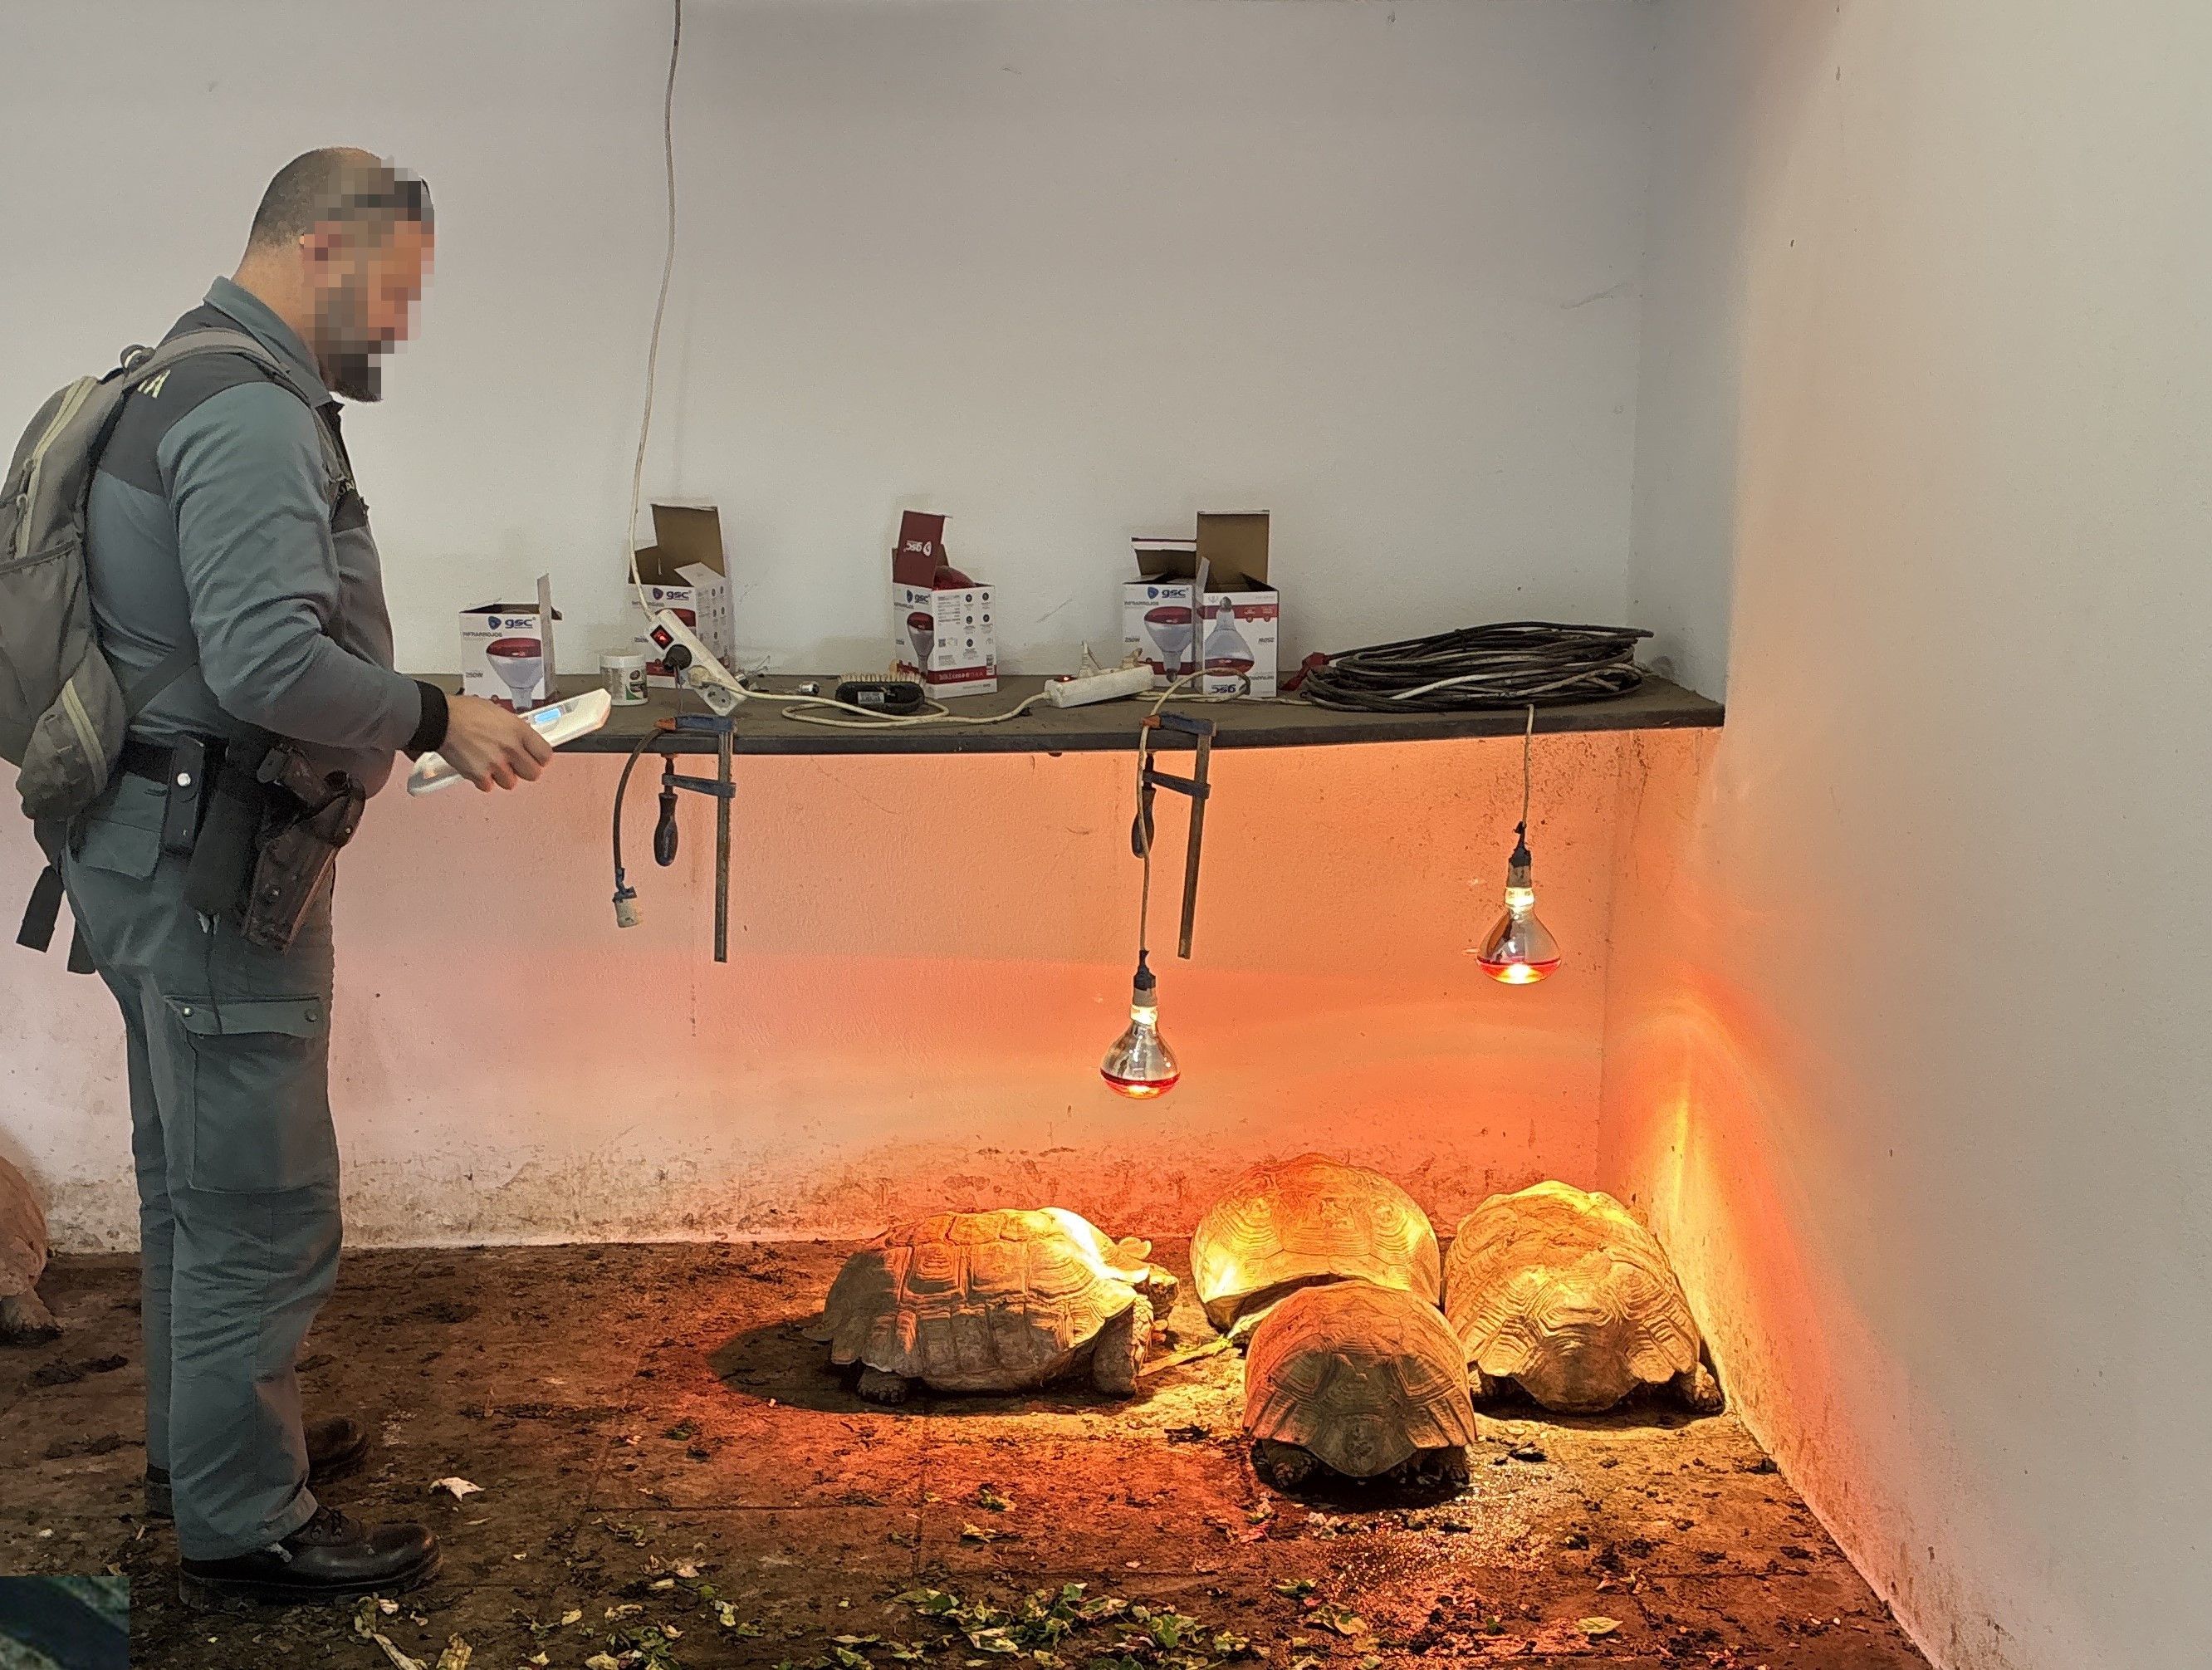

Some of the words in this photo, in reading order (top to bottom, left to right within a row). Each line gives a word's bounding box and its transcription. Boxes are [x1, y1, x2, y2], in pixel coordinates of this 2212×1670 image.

[666, 590, 690, 601] gsc
[1162, 589, 1187, 599] gsc
[914, 594, 929, 605] gsc
[505, 619, 533, 629] gsc
[1211, 684, 1236, 693] gsc
